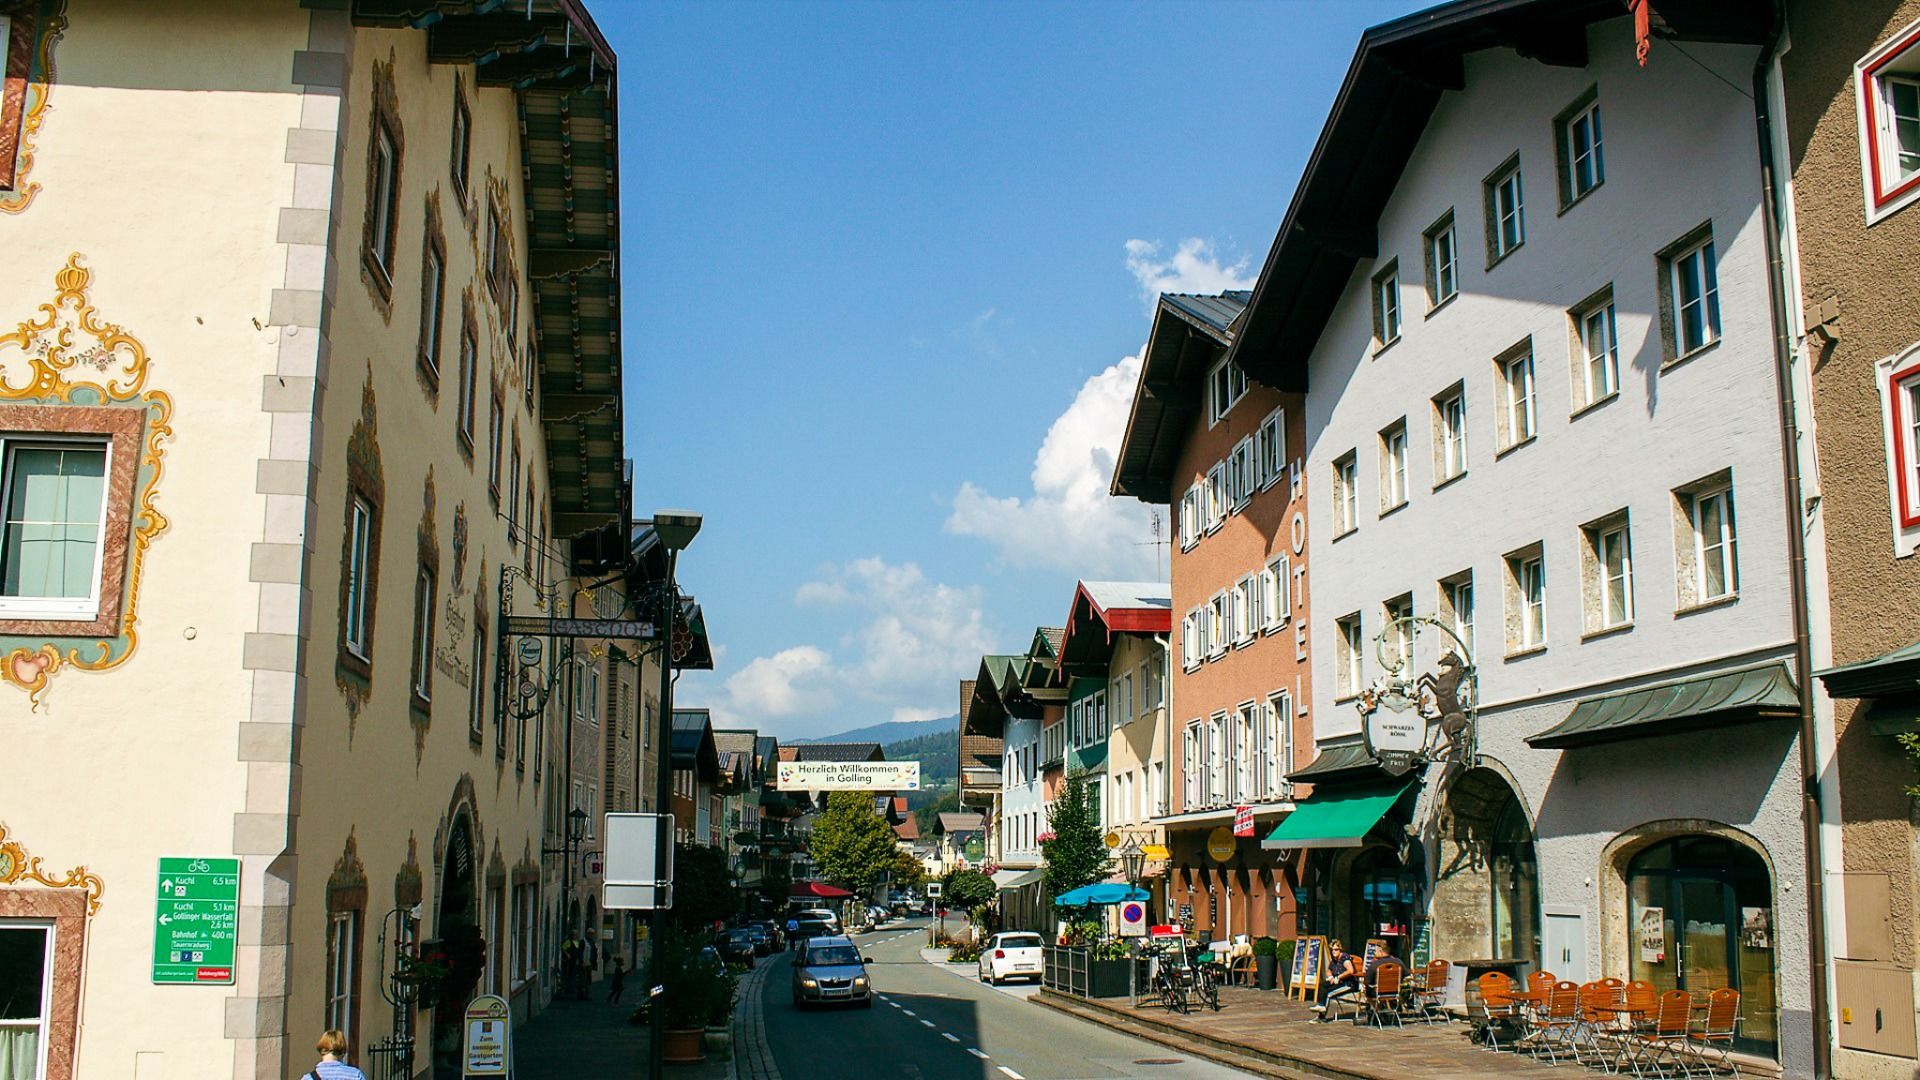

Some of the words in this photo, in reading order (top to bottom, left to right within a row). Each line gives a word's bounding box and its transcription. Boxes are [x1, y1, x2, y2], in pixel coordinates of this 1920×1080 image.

[1289, 457, 1308, 718] HOTEL
[798, 765, 837, 774] Herzlich
[839, 765, 899, 774] Willkommen
[826, 774, 835, 783] in
[837, 774, 872, 784] Golling
[175, 876, 195, 885] Kuchl
[212, 877, 224, 886] 6,5
[225, 878, 237, 886] km
[174, 902, 194, 911] Kuchl
[212, 903, 222, 911] 5,1
[223, 903, 235, 911] km
[173, 911, 200, 921] Gollinger
[201, 912, 233, 920] Wasserfall
[210, 921, 221, 929] 2,6
[222, 921, 234, 929] km
[172, 930, 198, 939] Bahnhof
[211, 931, 225, 939] 400
